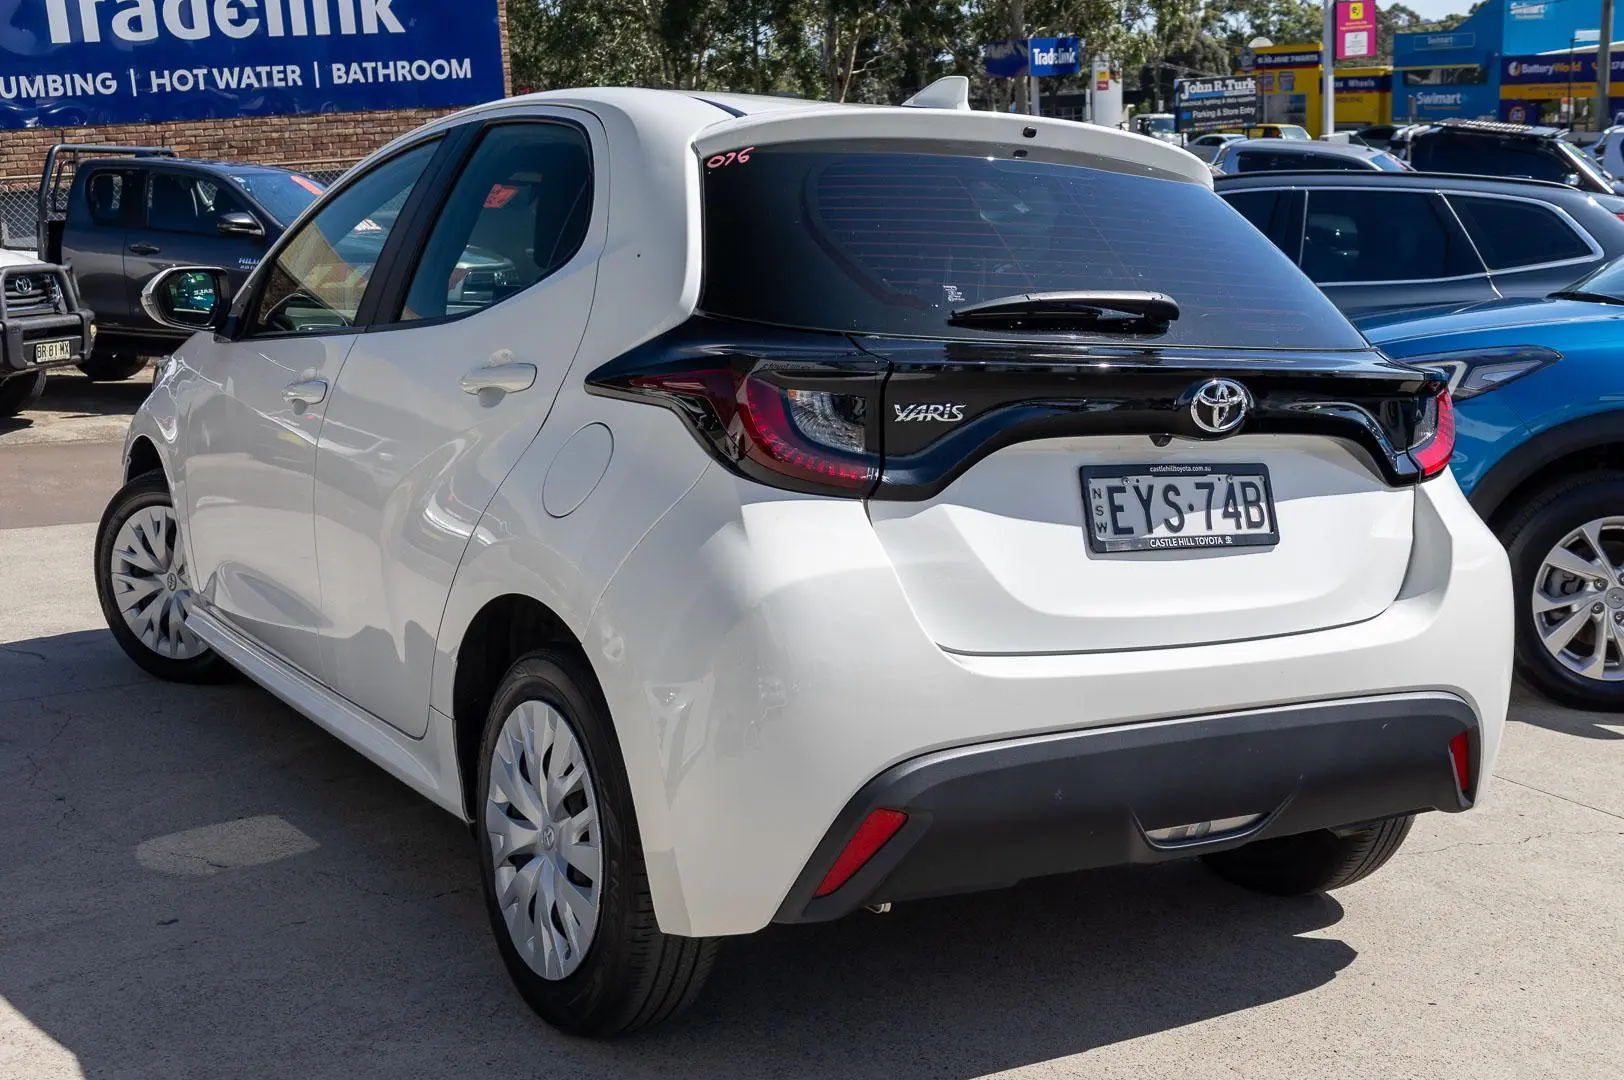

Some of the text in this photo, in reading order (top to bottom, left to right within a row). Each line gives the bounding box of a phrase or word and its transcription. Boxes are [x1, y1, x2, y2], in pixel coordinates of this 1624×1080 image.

[149, 69, 208, 93] HOT
[212, 65, 302, 90] WATER
[332, 58, 472, 85] BATHROOM
[1180, 81, 1212, 100] John
[1226, 77, 1256, 90] Turk
[1416, 92, 1461, 104] Swimart
[1192, 110, 1216, 119] Parking
[1223, 107, 1239, 116] Store
[1239, 106, 1256, 116] Entry
[706, 146, 755, 169] 076
[1149, 464, 1212, 473] castlehilltoyota.com.au
[1150, 535, 1224, 548] CASTLE HILL TOYOTA
